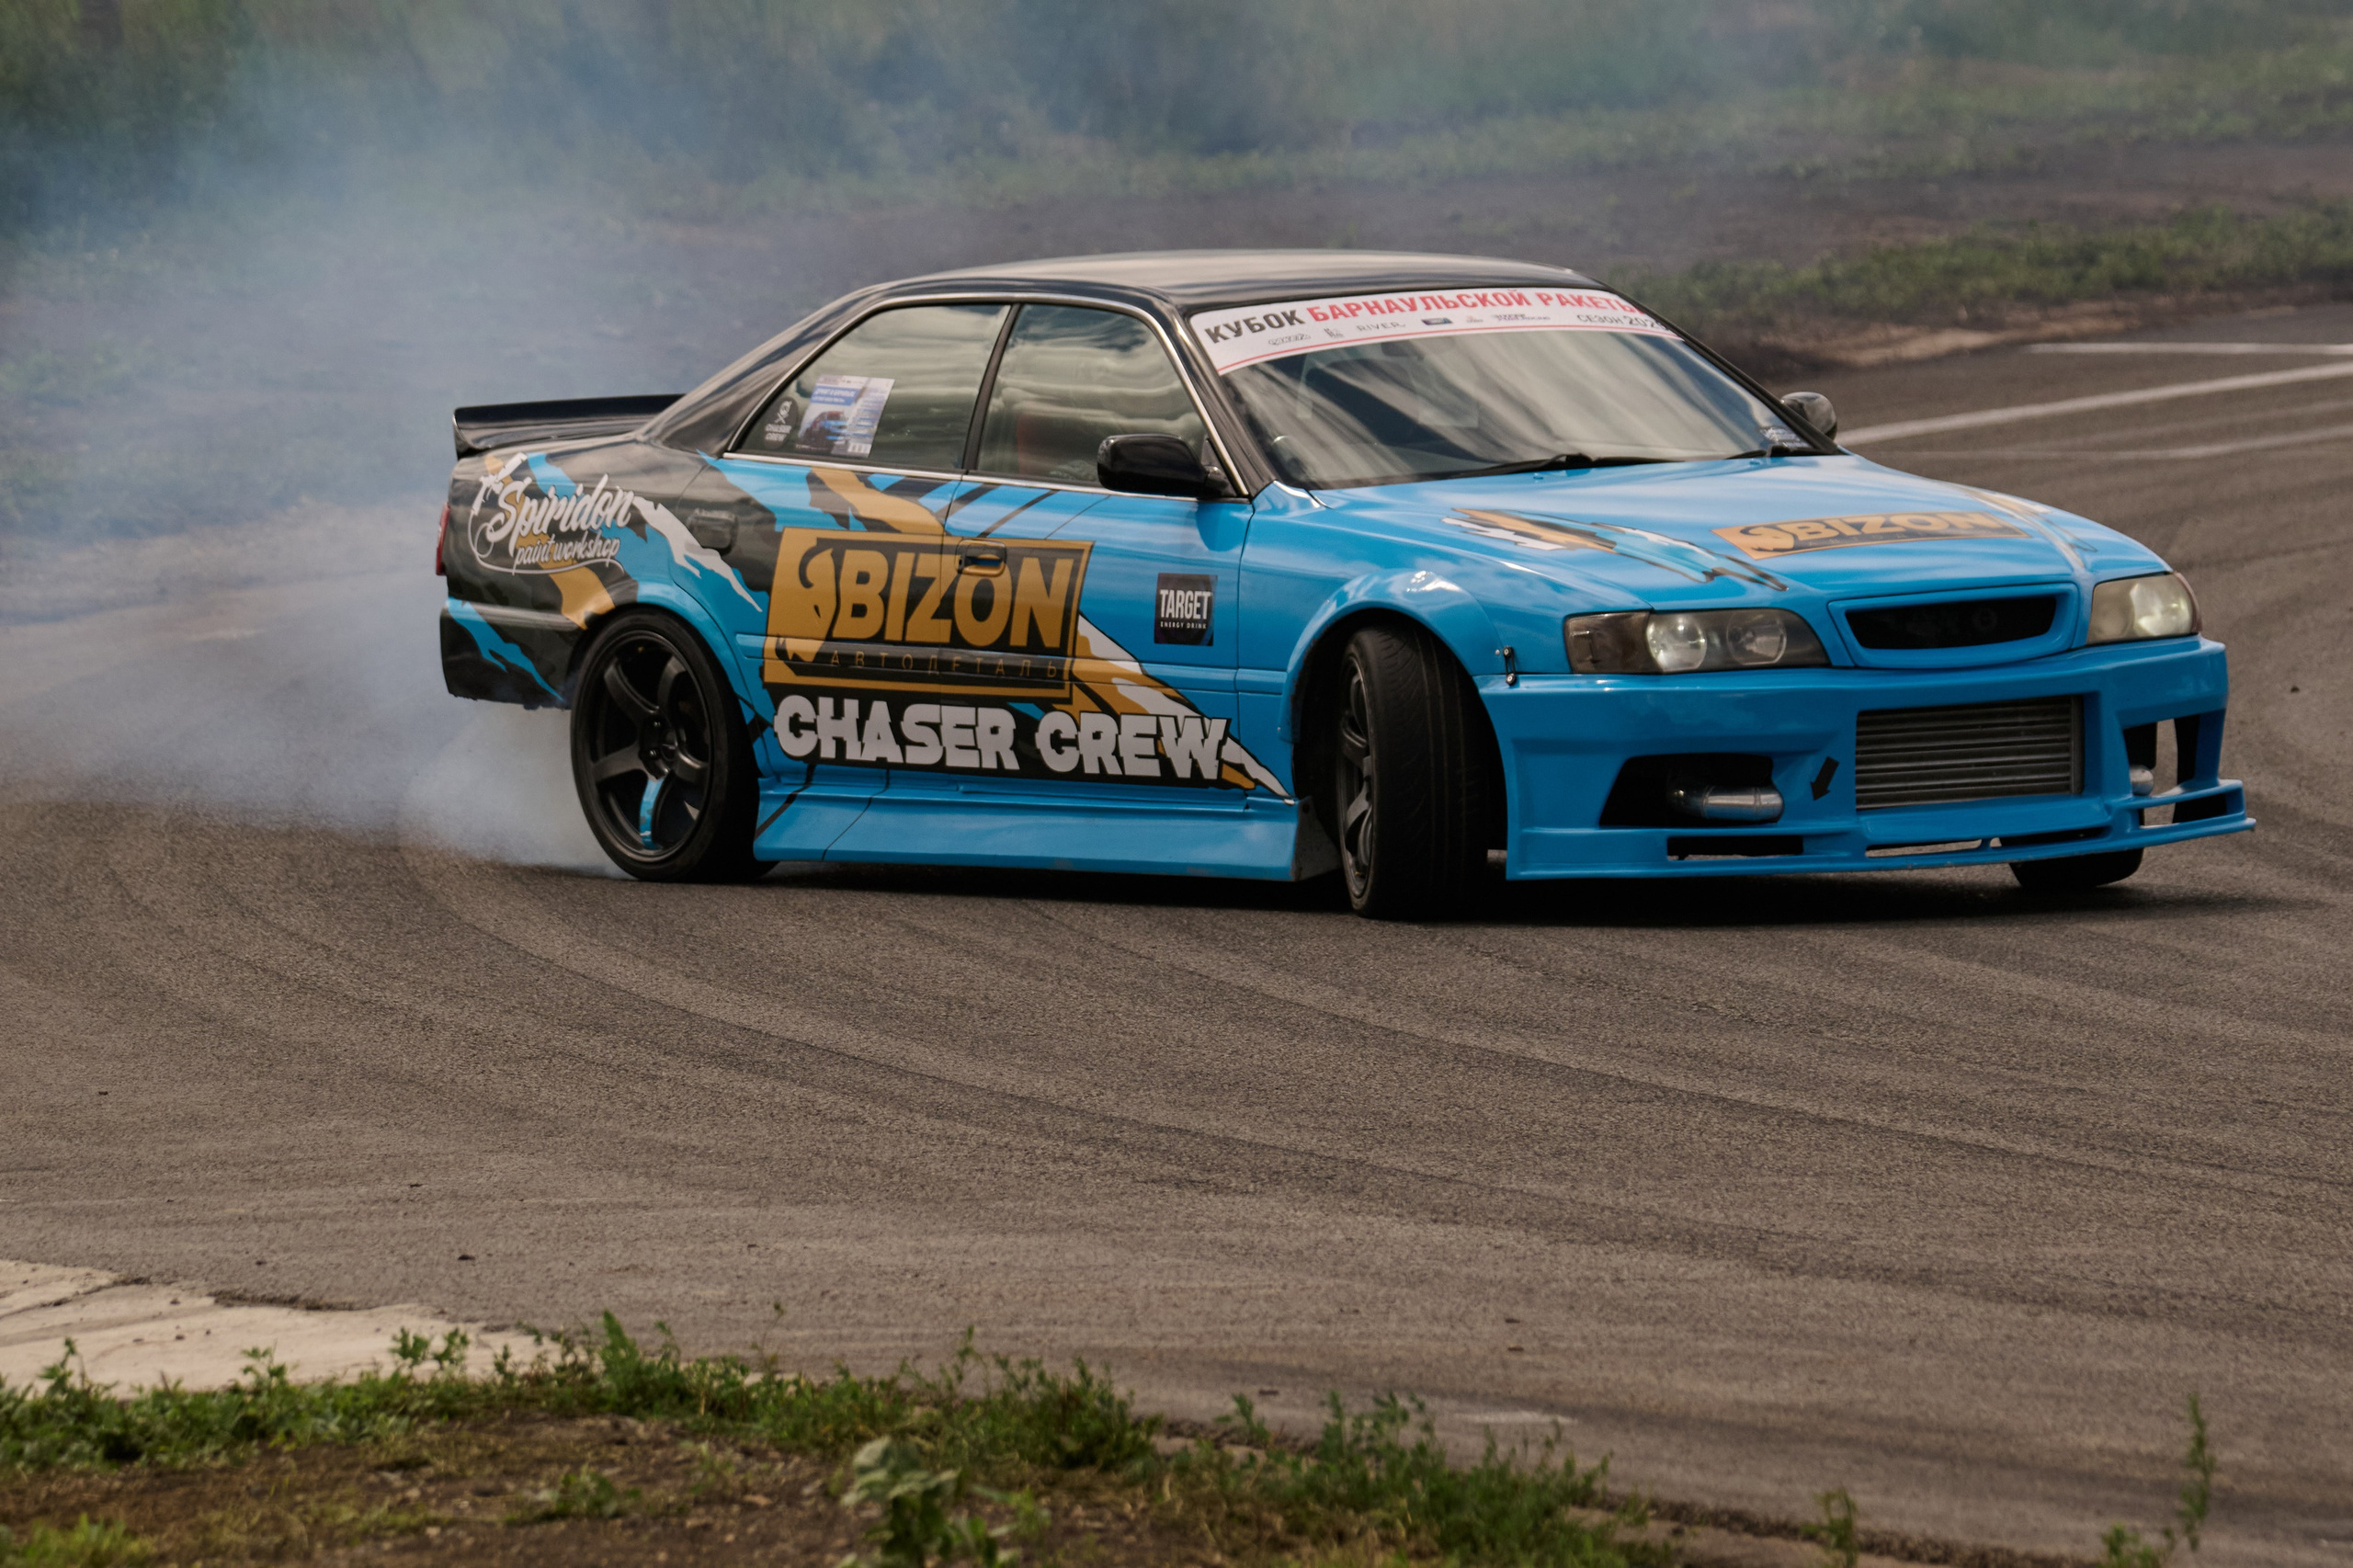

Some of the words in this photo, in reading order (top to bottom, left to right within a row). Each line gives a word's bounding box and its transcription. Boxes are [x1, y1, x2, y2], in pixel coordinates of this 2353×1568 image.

[1204, 309, 1306, 344] КУБОК
[1306, 289, 1531, 322] БАРНАУЛЬСКОЙ
[1576, 314, 1622, 324] СЕЗОН
[486, 473, 634, 557] Spiridon
[1777, 513, 2003, 540] BIZON
[512, 533, 555, 575] paint
[553, 531, 620, 567] workshop
[833, 549, 1074, 648] BIZON
[1160, 589, 1211, 619] TARGET
[830, 650, 1057, 678] АВТОДЕТАЛЬ
[774, 695, 1019, 770] CHASER
[1035, 711, 1231, 780] CREW
